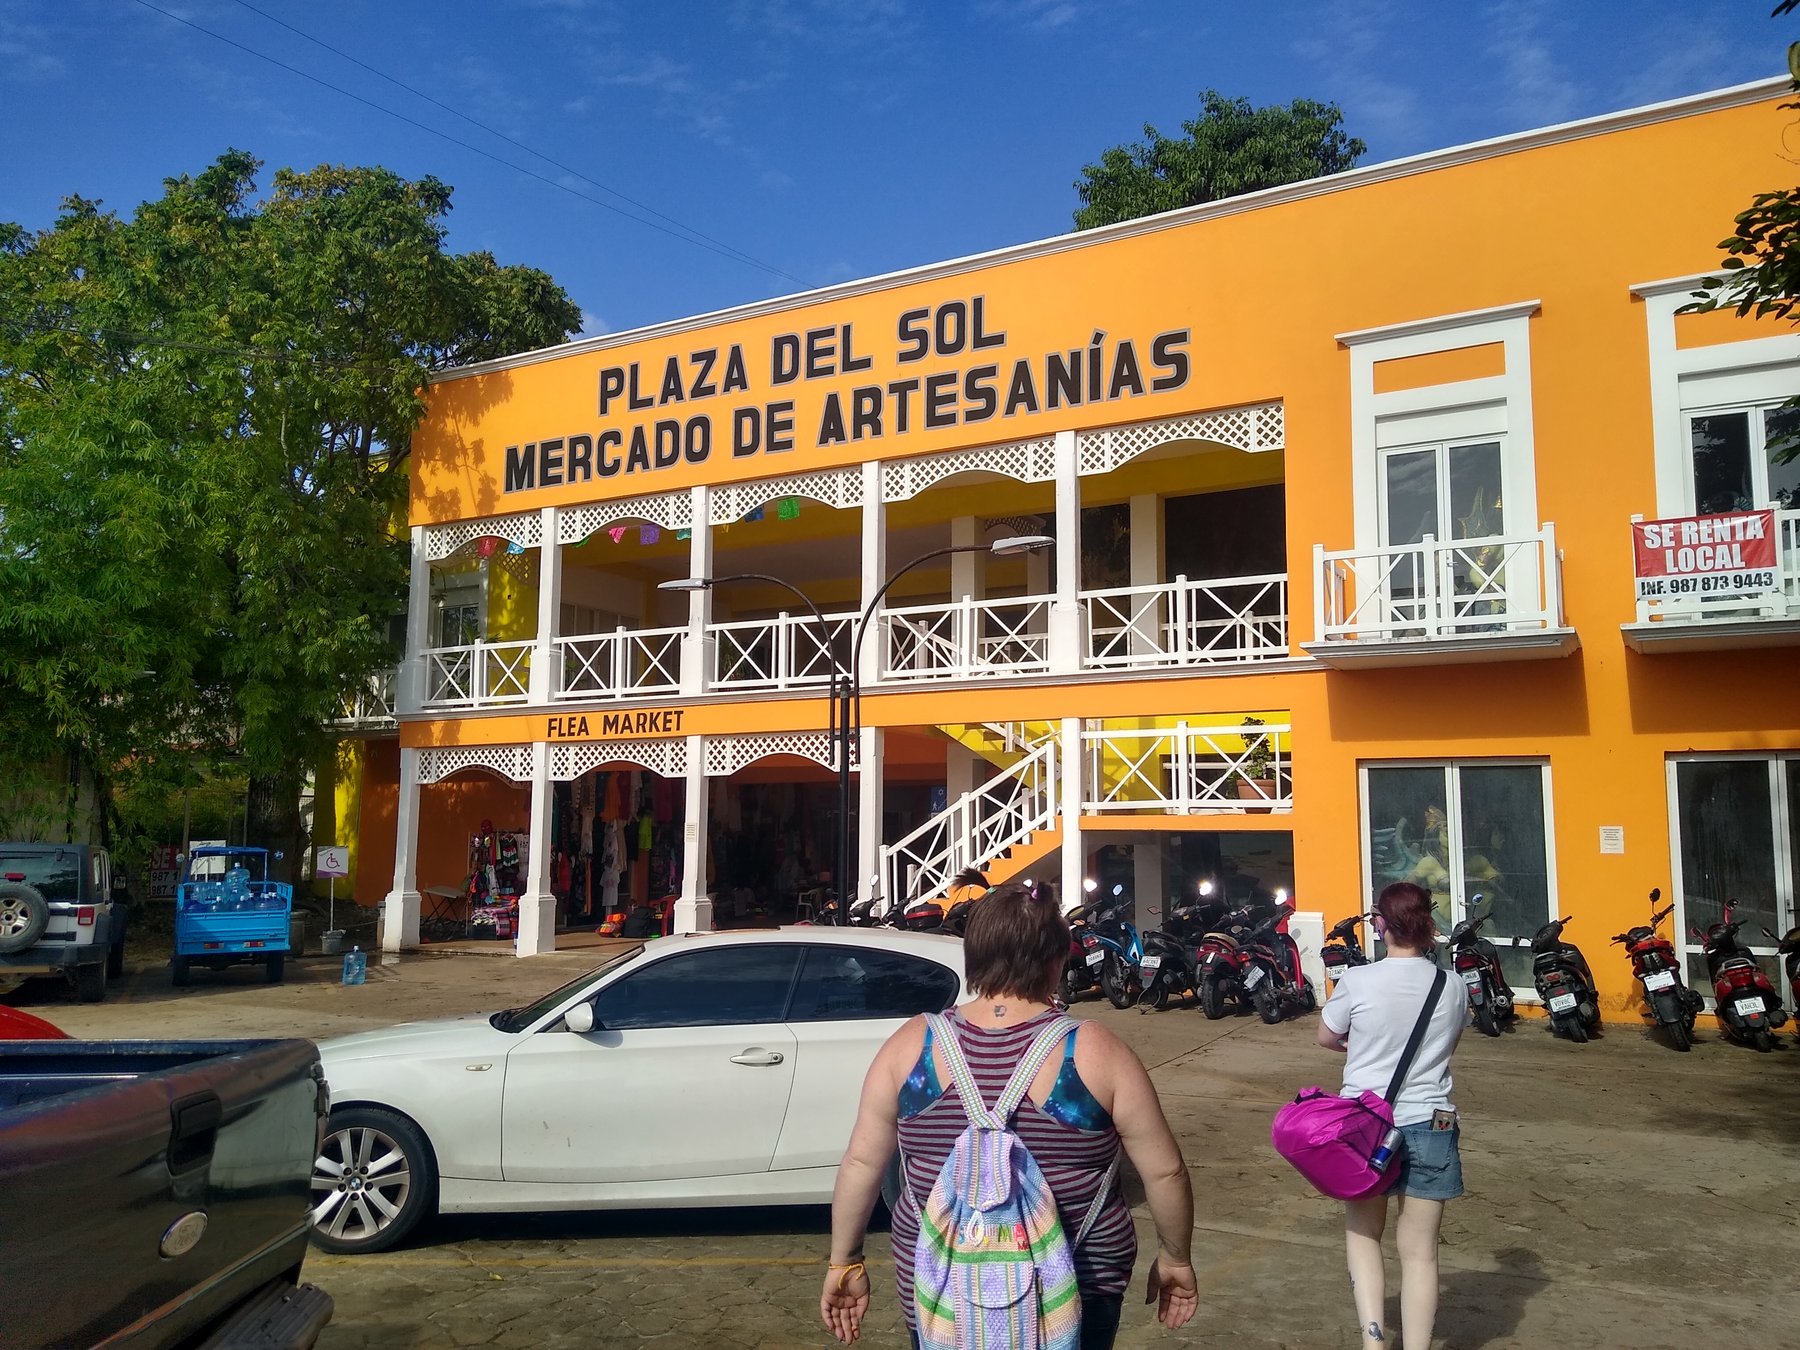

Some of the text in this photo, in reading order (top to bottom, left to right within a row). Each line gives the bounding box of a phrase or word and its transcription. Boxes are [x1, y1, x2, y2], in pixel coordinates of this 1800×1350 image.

[598, 294, 1007, 417] PLAZA DEL SOL
[503, 327, 1191, 494] MERCADO DE ARTESANÍAS
[1643, 514, 1765, 548] SE RENTA
[1665, 543, 1746, 574] LOCAL
[1641, 572, 1774, 596] INF. 987 873 9443
[547, 710, 684, 738] FLEA MARKET
[152, 848, 171, 869] SE
[151, 884, 168, 895] 987
[152, 871, 169, 881] 987
